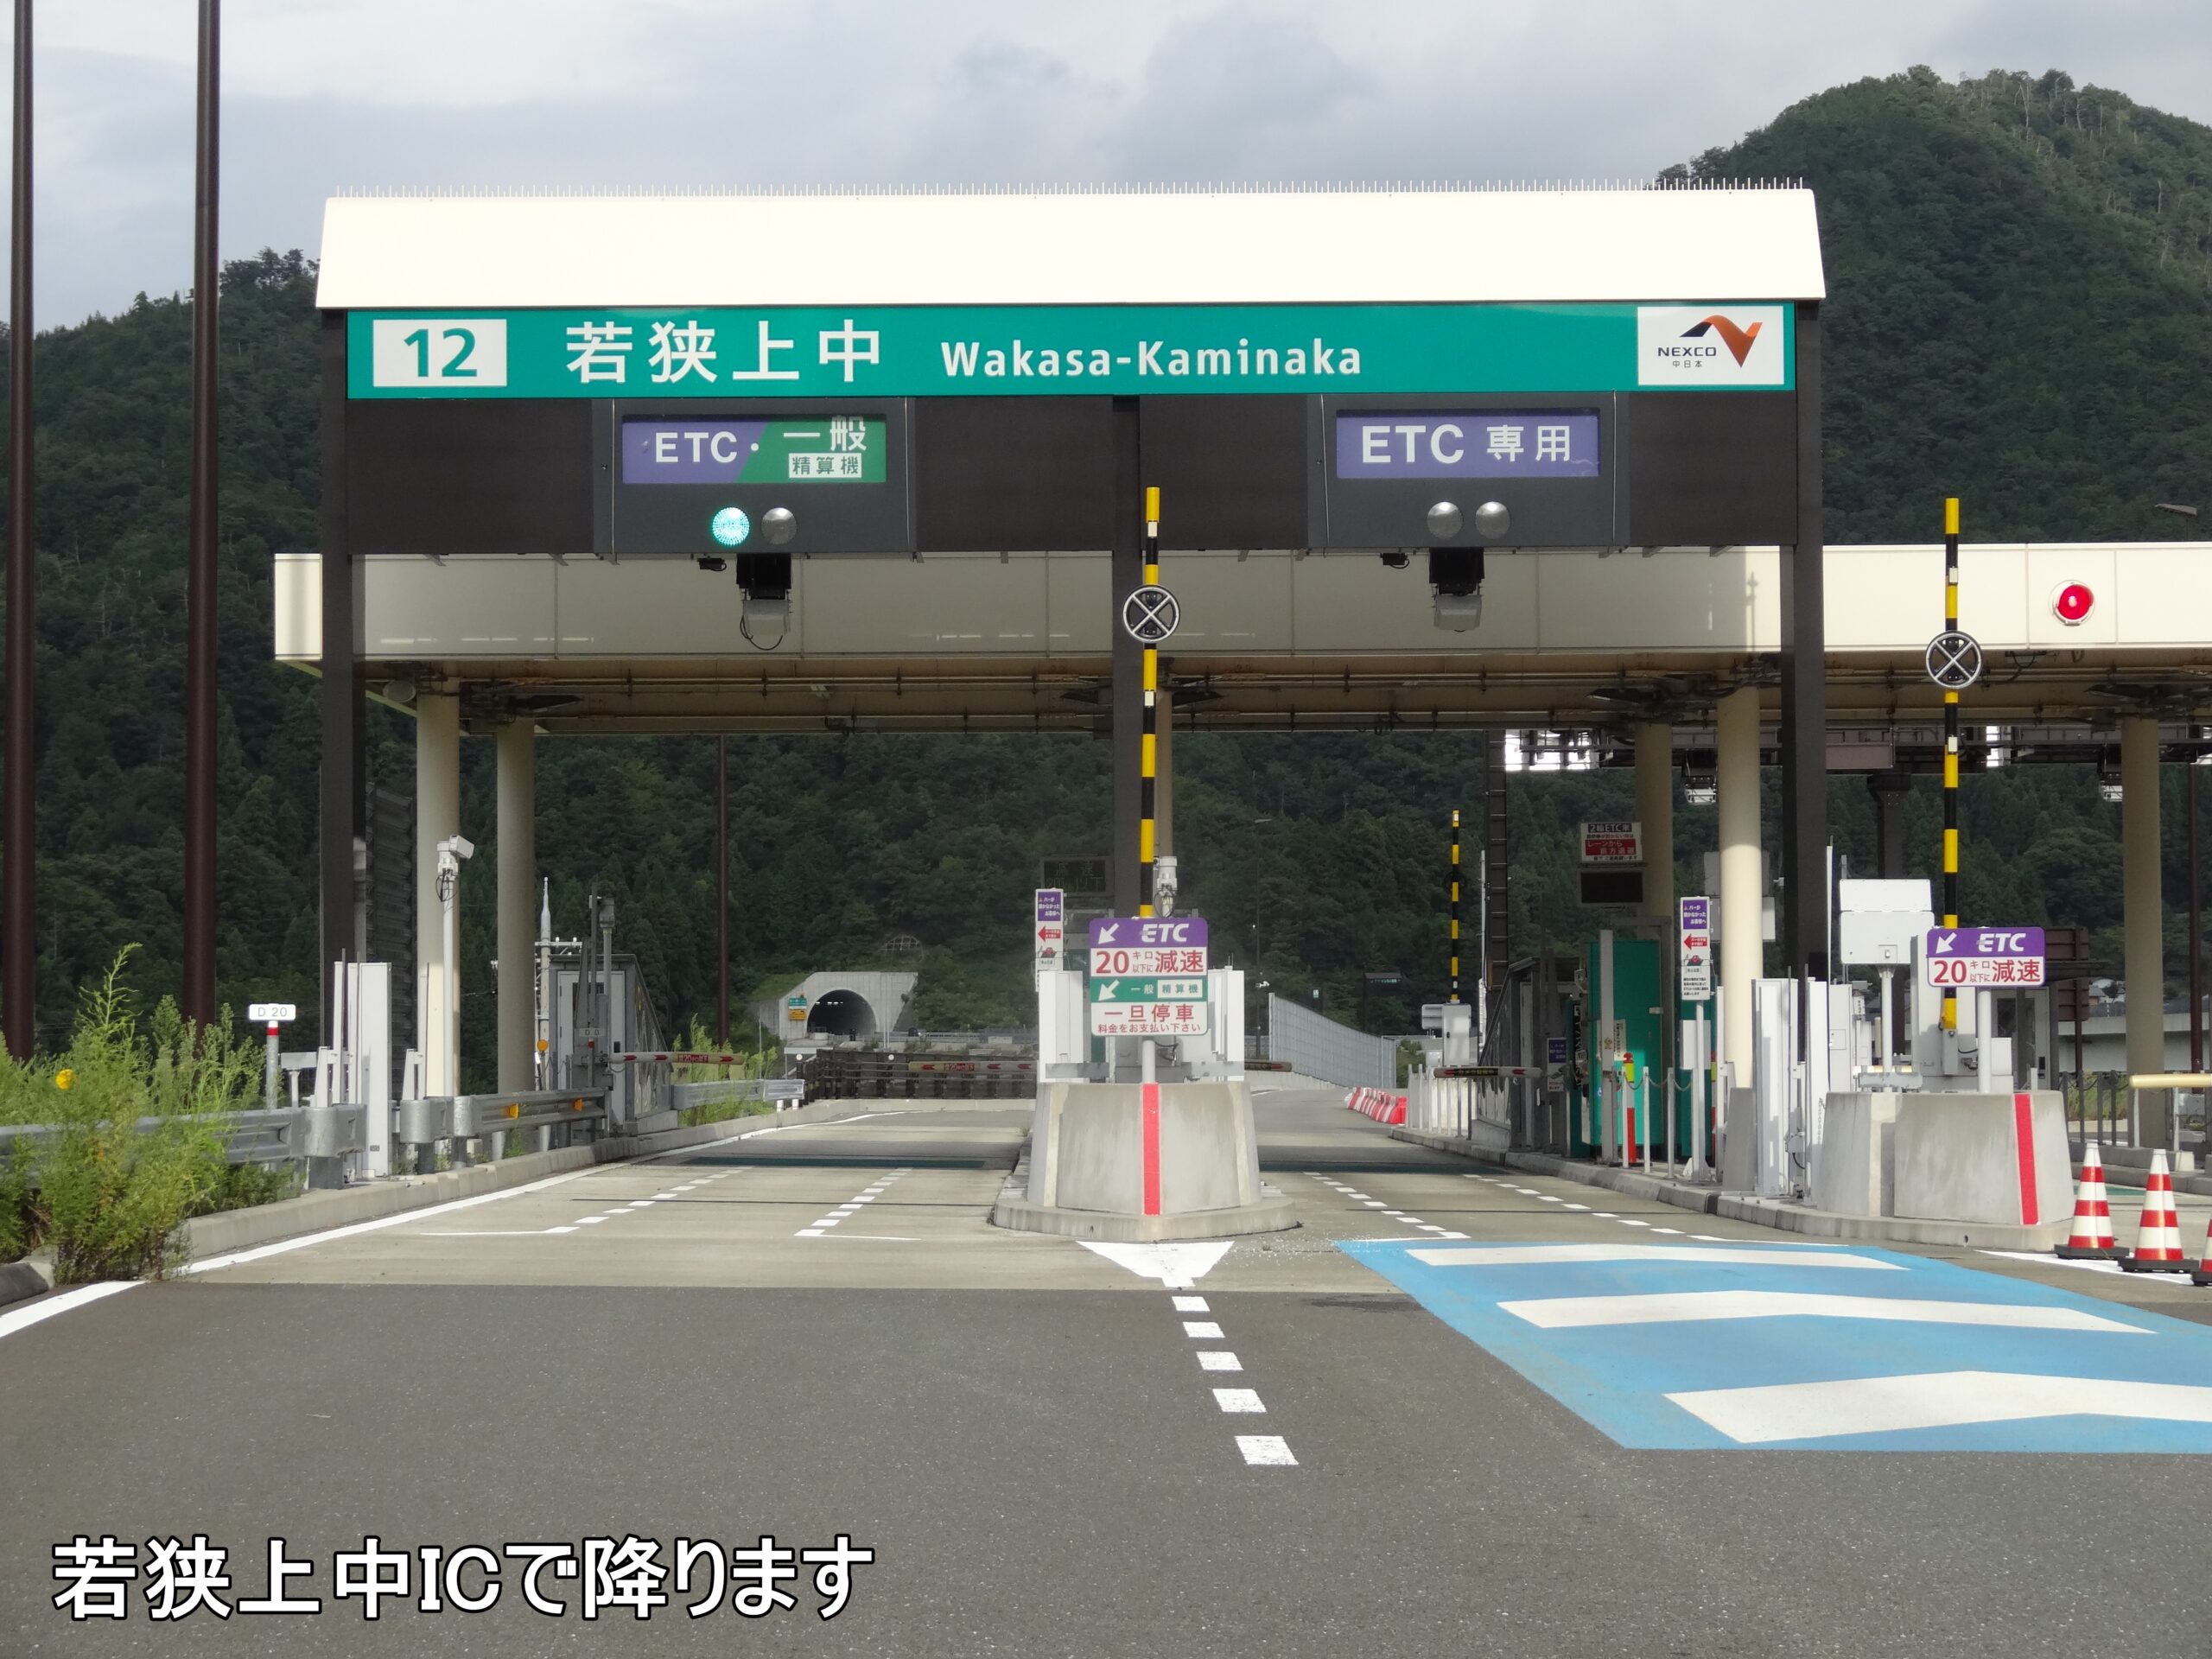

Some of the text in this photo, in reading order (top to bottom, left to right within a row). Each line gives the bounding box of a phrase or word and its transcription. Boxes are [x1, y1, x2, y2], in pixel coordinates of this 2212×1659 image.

[404, 327, 478, 378] 12
[566, 319, 880, 384] 若狭上中
[941, 338, 1361, 377] Wakasa-Kaminaka
[1657, 346, 1717, 357] NEXCO
[1672, 359, 1702, 368] 中日本
[782, 415, 868, 453] 一般
[1362, 423, 1570, 464] ETC 専用
[791, 455, 859, 475] 精算機
[1141, 923, 1190, 943] ETC
[1978, 932, 2027, 952] ETC
[1096, 950, 1204, 974] 20 キロ 以下に 減速
[1934, 959, 2041, 983] 20 キロ 以下に 減速
[1130, 983, 1198, 995] 一般 精算機
[257, 1007, 288, 1017] D 20
[1104, 1003, 1194, 1023] 一旦停車
[1097, 1023, 1201, 1033] 料金をお支払い下さい
